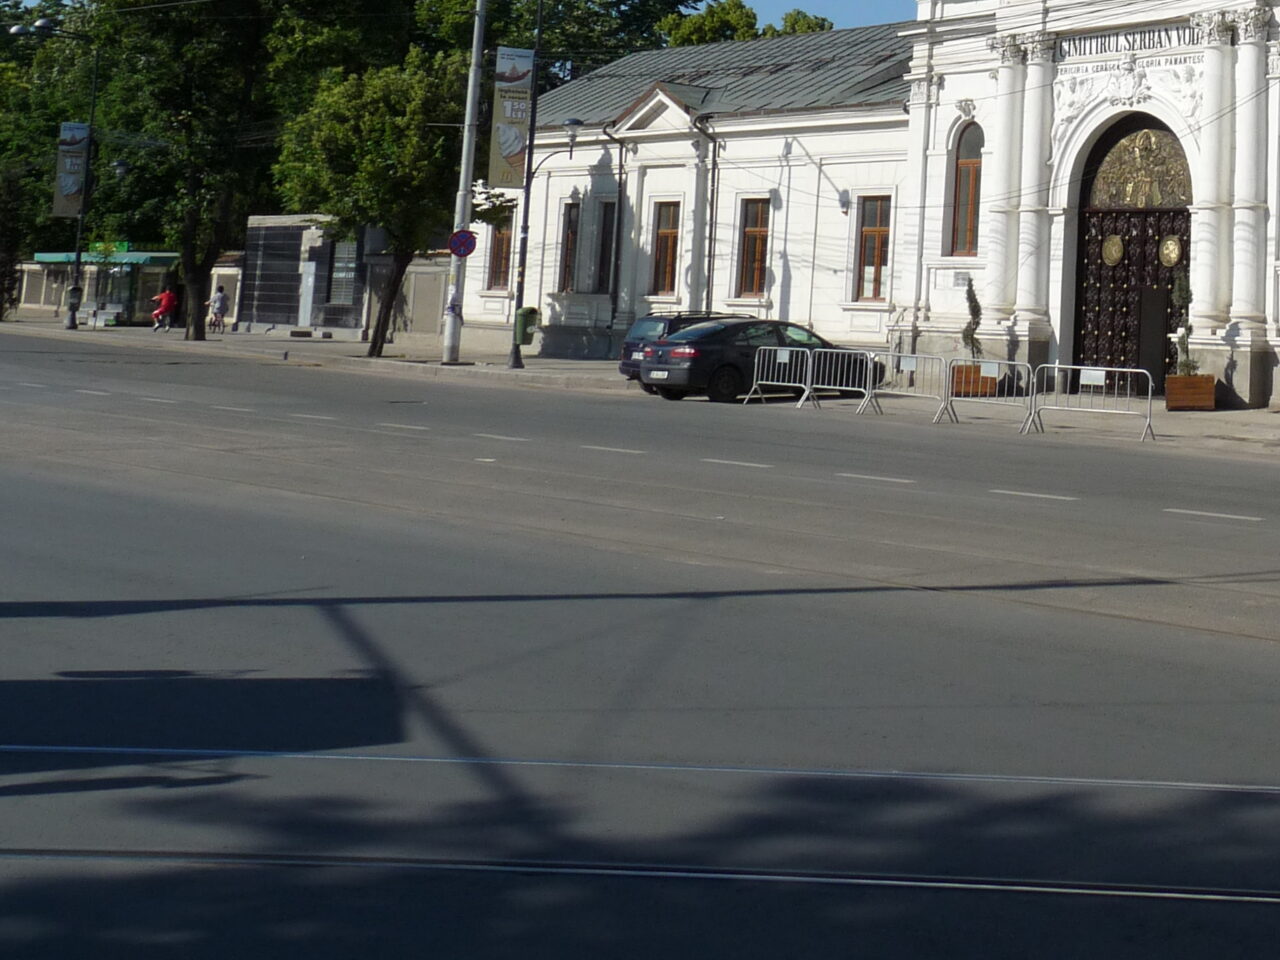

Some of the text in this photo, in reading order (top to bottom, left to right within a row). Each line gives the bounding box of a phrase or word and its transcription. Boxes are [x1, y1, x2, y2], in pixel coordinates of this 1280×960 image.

[1060, 33, 1122, 57] CIMITIRUL
[1124, 28, 1172, 51] SERBAN
[1138, 58, 1161, 68] GLORIA
